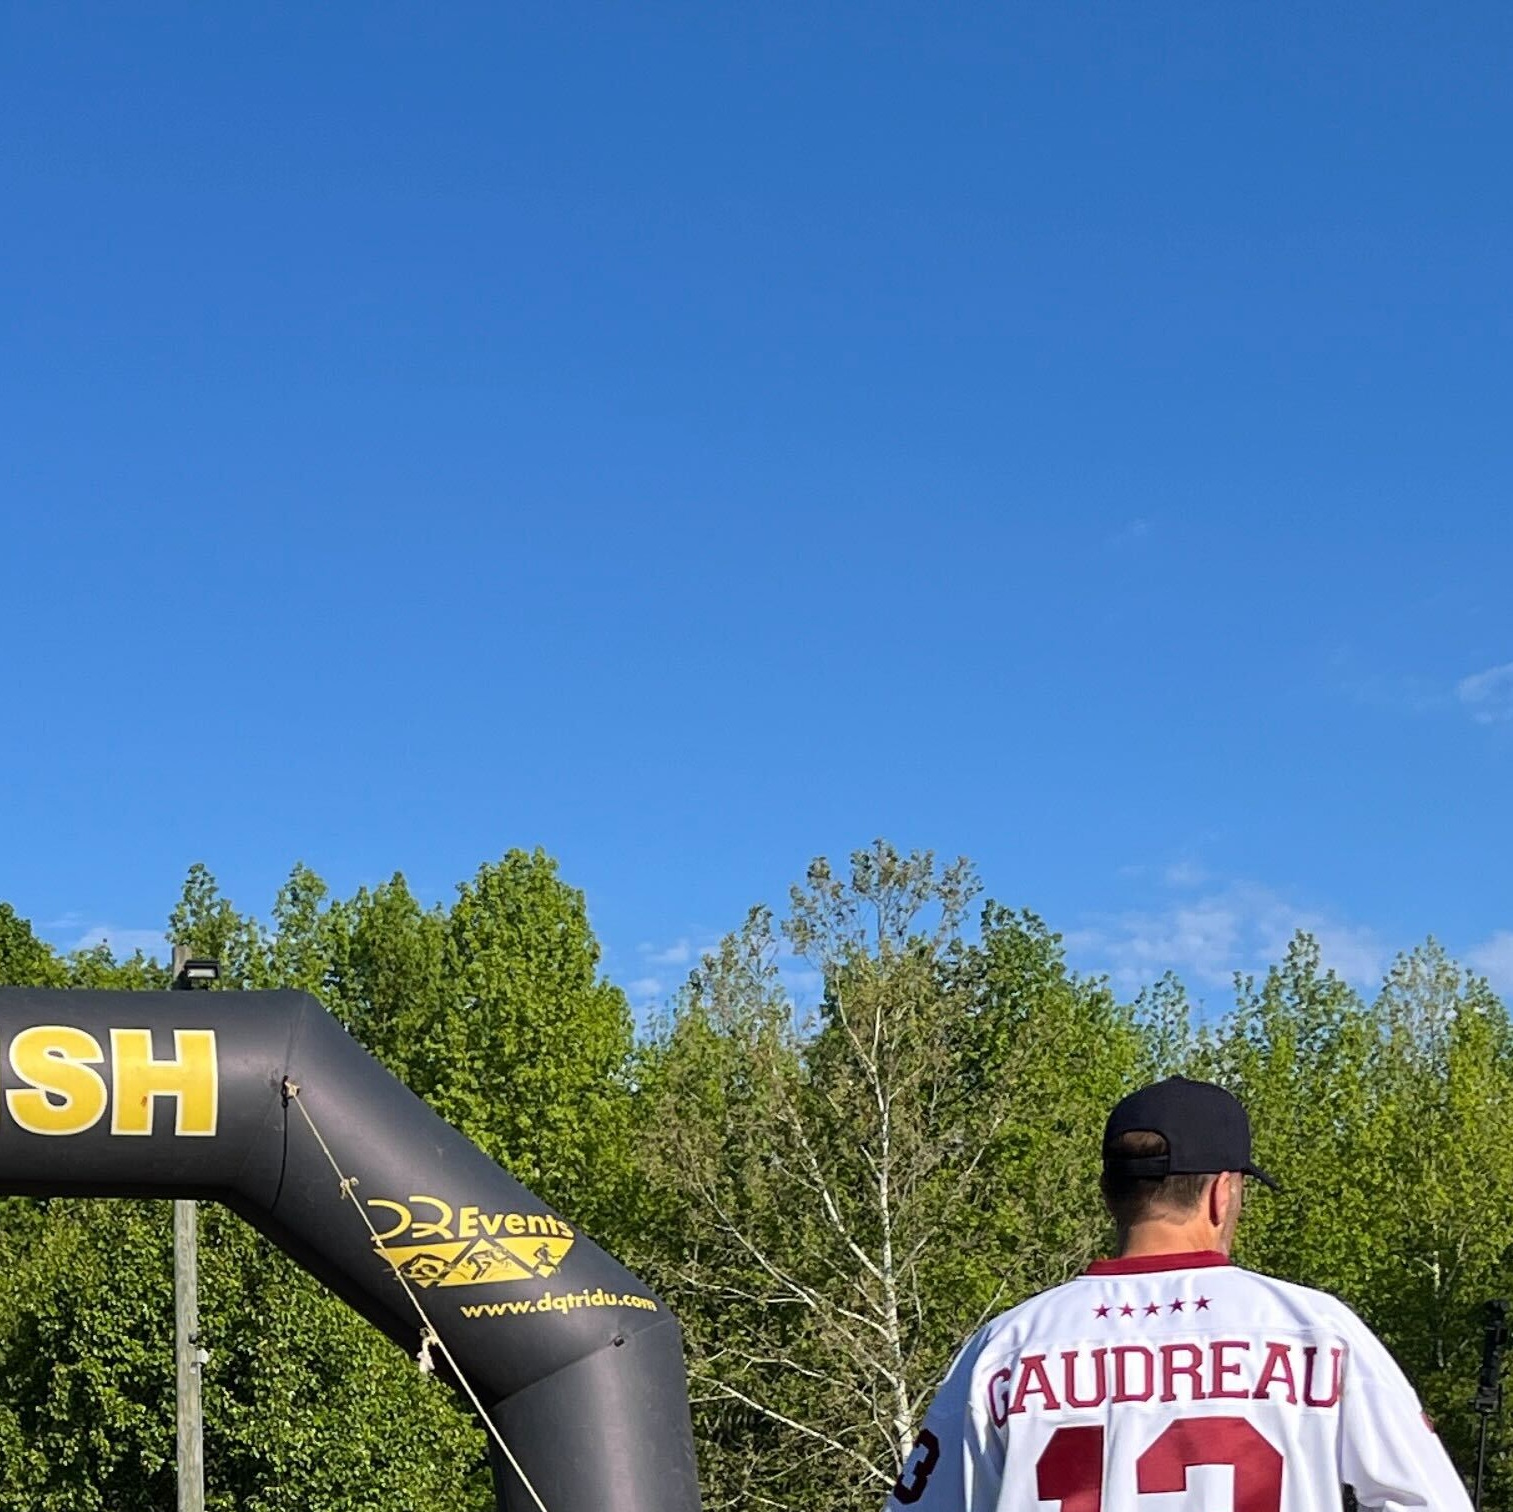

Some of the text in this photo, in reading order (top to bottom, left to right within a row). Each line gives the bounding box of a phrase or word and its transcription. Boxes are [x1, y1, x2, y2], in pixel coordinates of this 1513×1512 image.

[458, 1206, 574, 1238] Events
[460, 1288, 657, 1318] www.dqtridu.com
[988, 1340, 1343, 1428] GAUDREAU
